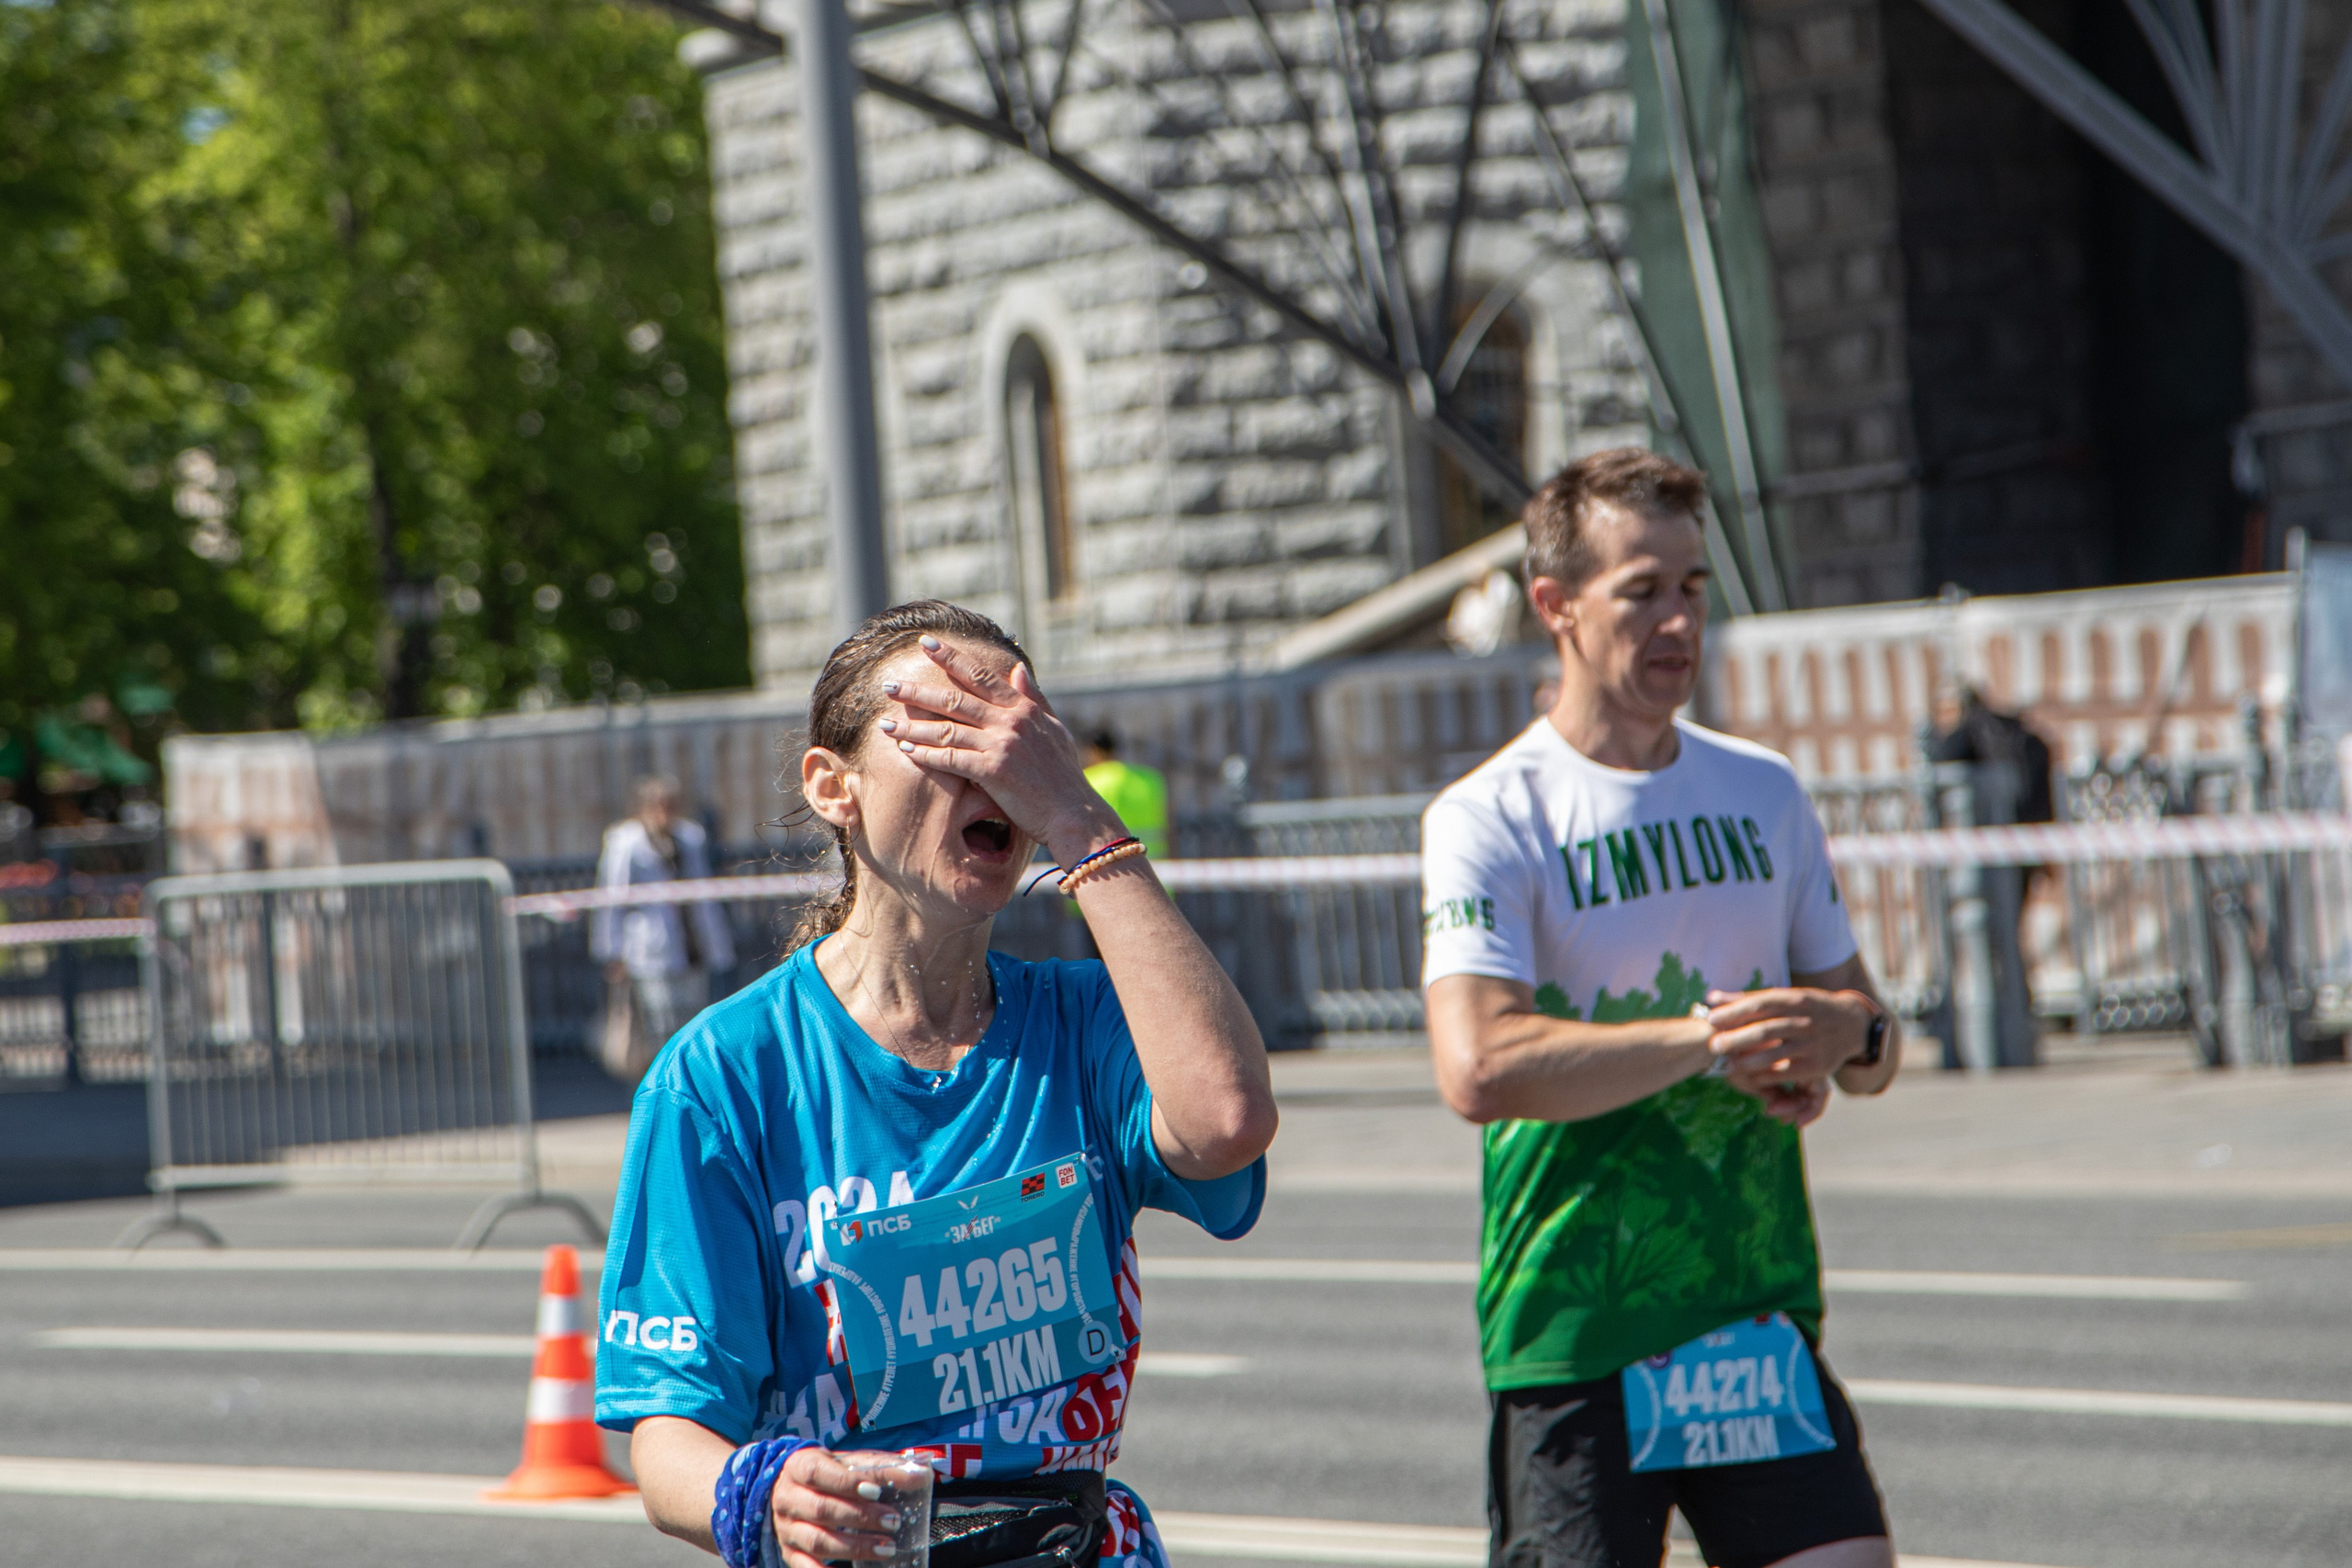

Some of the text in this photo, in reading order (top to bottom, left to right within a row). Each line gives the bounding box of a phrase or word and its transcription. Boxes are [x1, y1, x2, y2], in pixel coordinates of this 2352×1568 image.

[1559, 813, 1775, 910] IZMYLONG
[1059, 1166, 1074, 1179] FON
[1060, 1174, 1076, 1187] BET
[867, 1213, 912, 1237] ПСБ
[899, 1236, 1068, 1348] 44265
[605, 1310, 698, 1351] ПСБ
[1086, 1328, 1106, 1357] D
[1664, 1354, 1785, 1417] 44274
